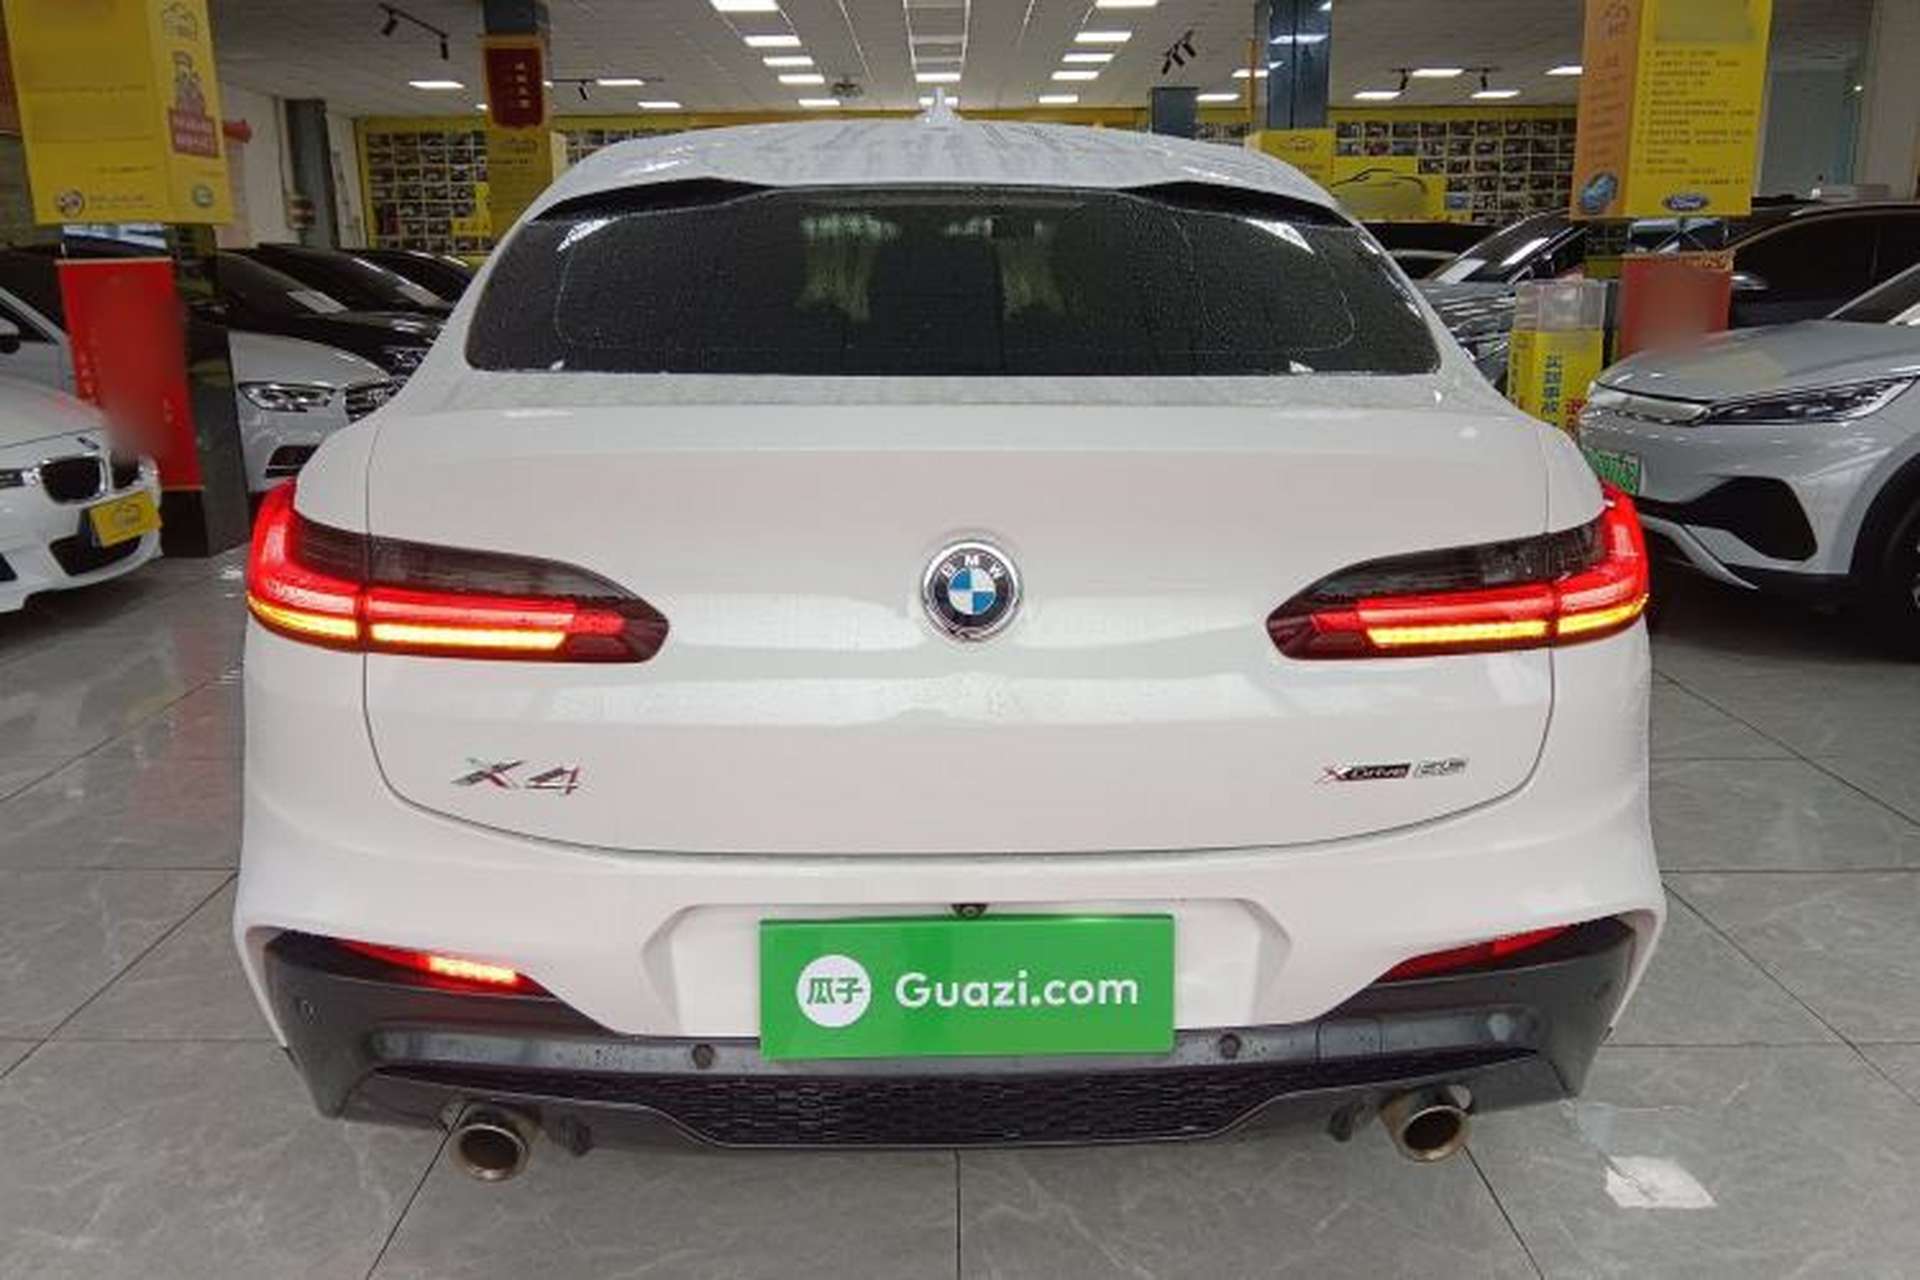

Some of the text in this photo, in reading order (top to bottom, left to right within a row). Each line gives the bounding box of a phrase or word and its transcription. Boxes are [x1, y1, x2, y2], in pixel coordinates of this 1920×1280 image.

[939, 553, 1007, 580] BMW
[806, 977, 863, 1004] 瓜子
[895, 969, 1139, 1008] Guazi.com
